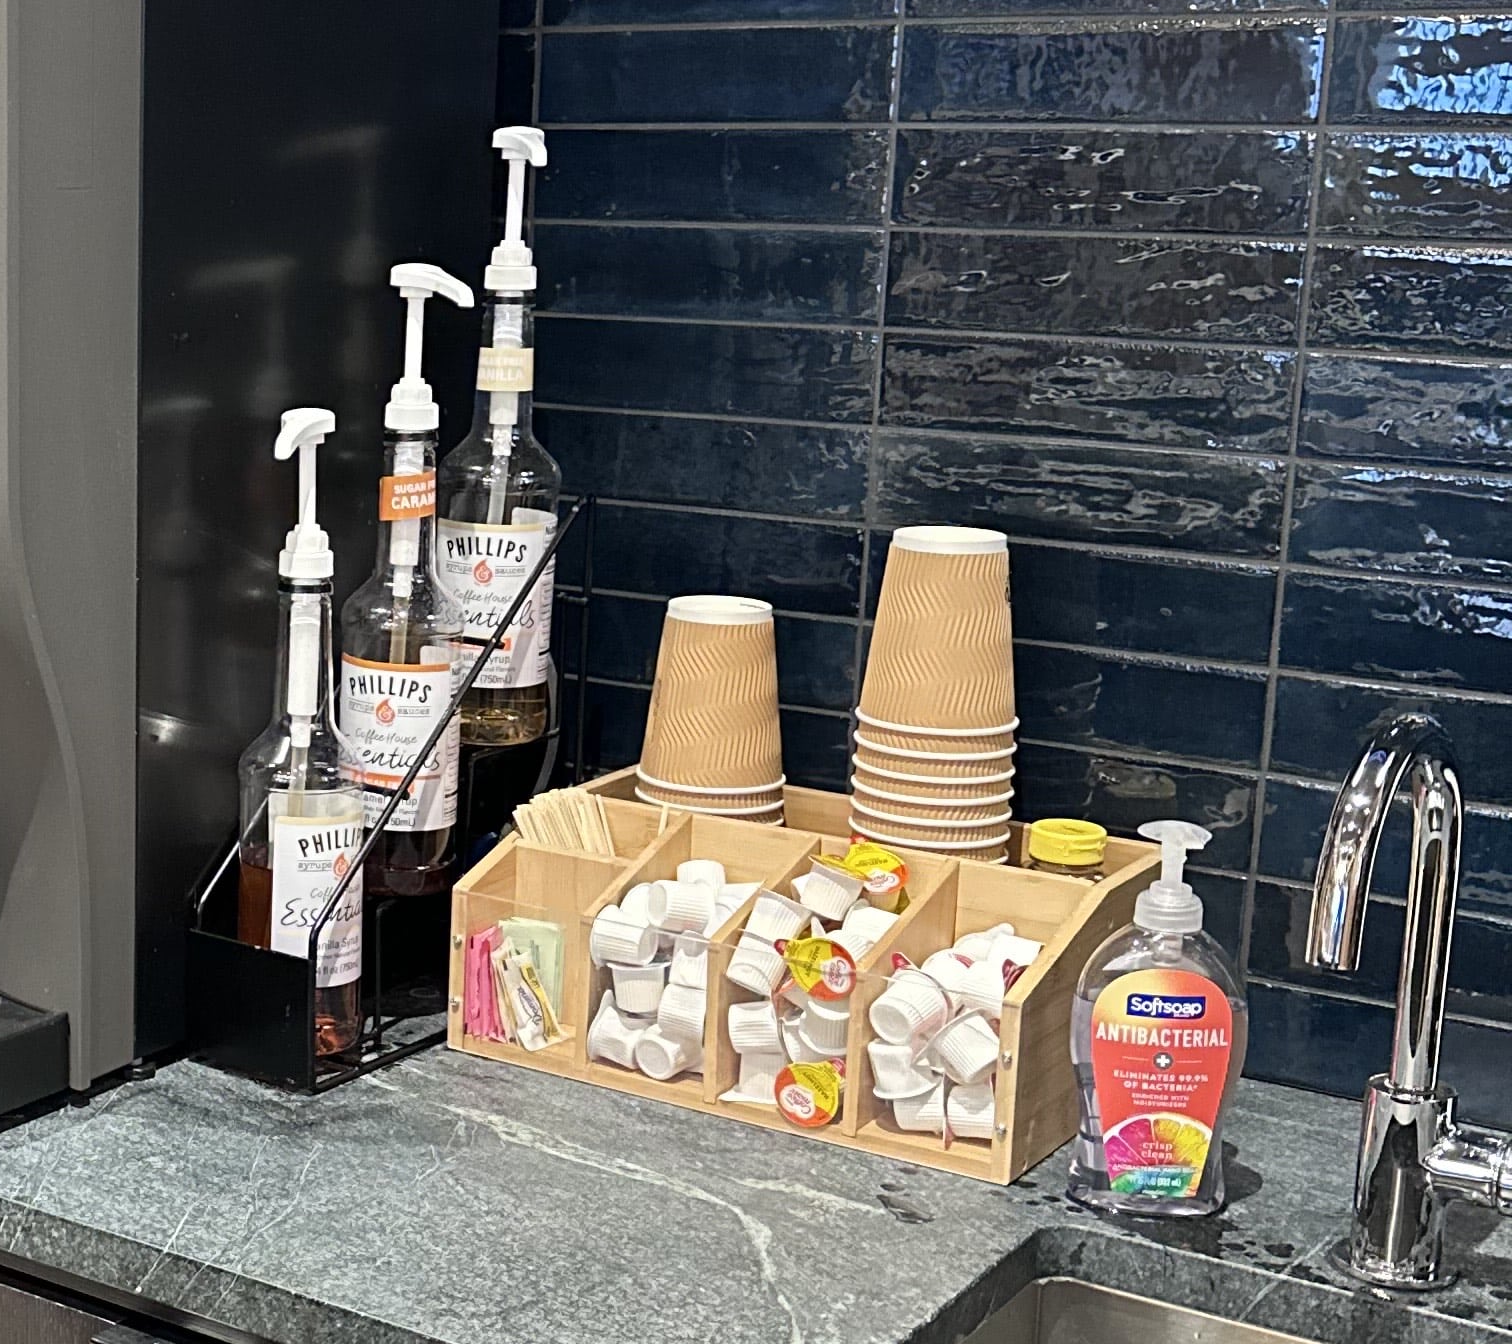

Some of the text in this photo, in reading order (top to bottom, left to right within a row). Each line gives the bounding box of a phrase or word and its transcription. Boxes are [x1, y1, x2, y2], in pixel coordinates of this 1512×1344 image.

[394, 482, 427, 494] SUGAR
[446, 536, 528, 563] PHILLIPS
[453, 588, 513, 605] Coffee House
[488, 655, 510, 664] yrup
[349, 674, 432, 703] PHILLIPS
[355, 728, 418, 746] Coffee House
[1130, 997, 1203, 1016] Softsoap
[1095, 1021, 1229, 1048] ANTIBACTERIAL
[1113, 1069, 1176, 1082] ELIMINATES
[1123, 1080, 1138, 1089] OF
[1142, 1141, 1174, 1151] crisp
[1140, 1150, 1174, 1160] clean
